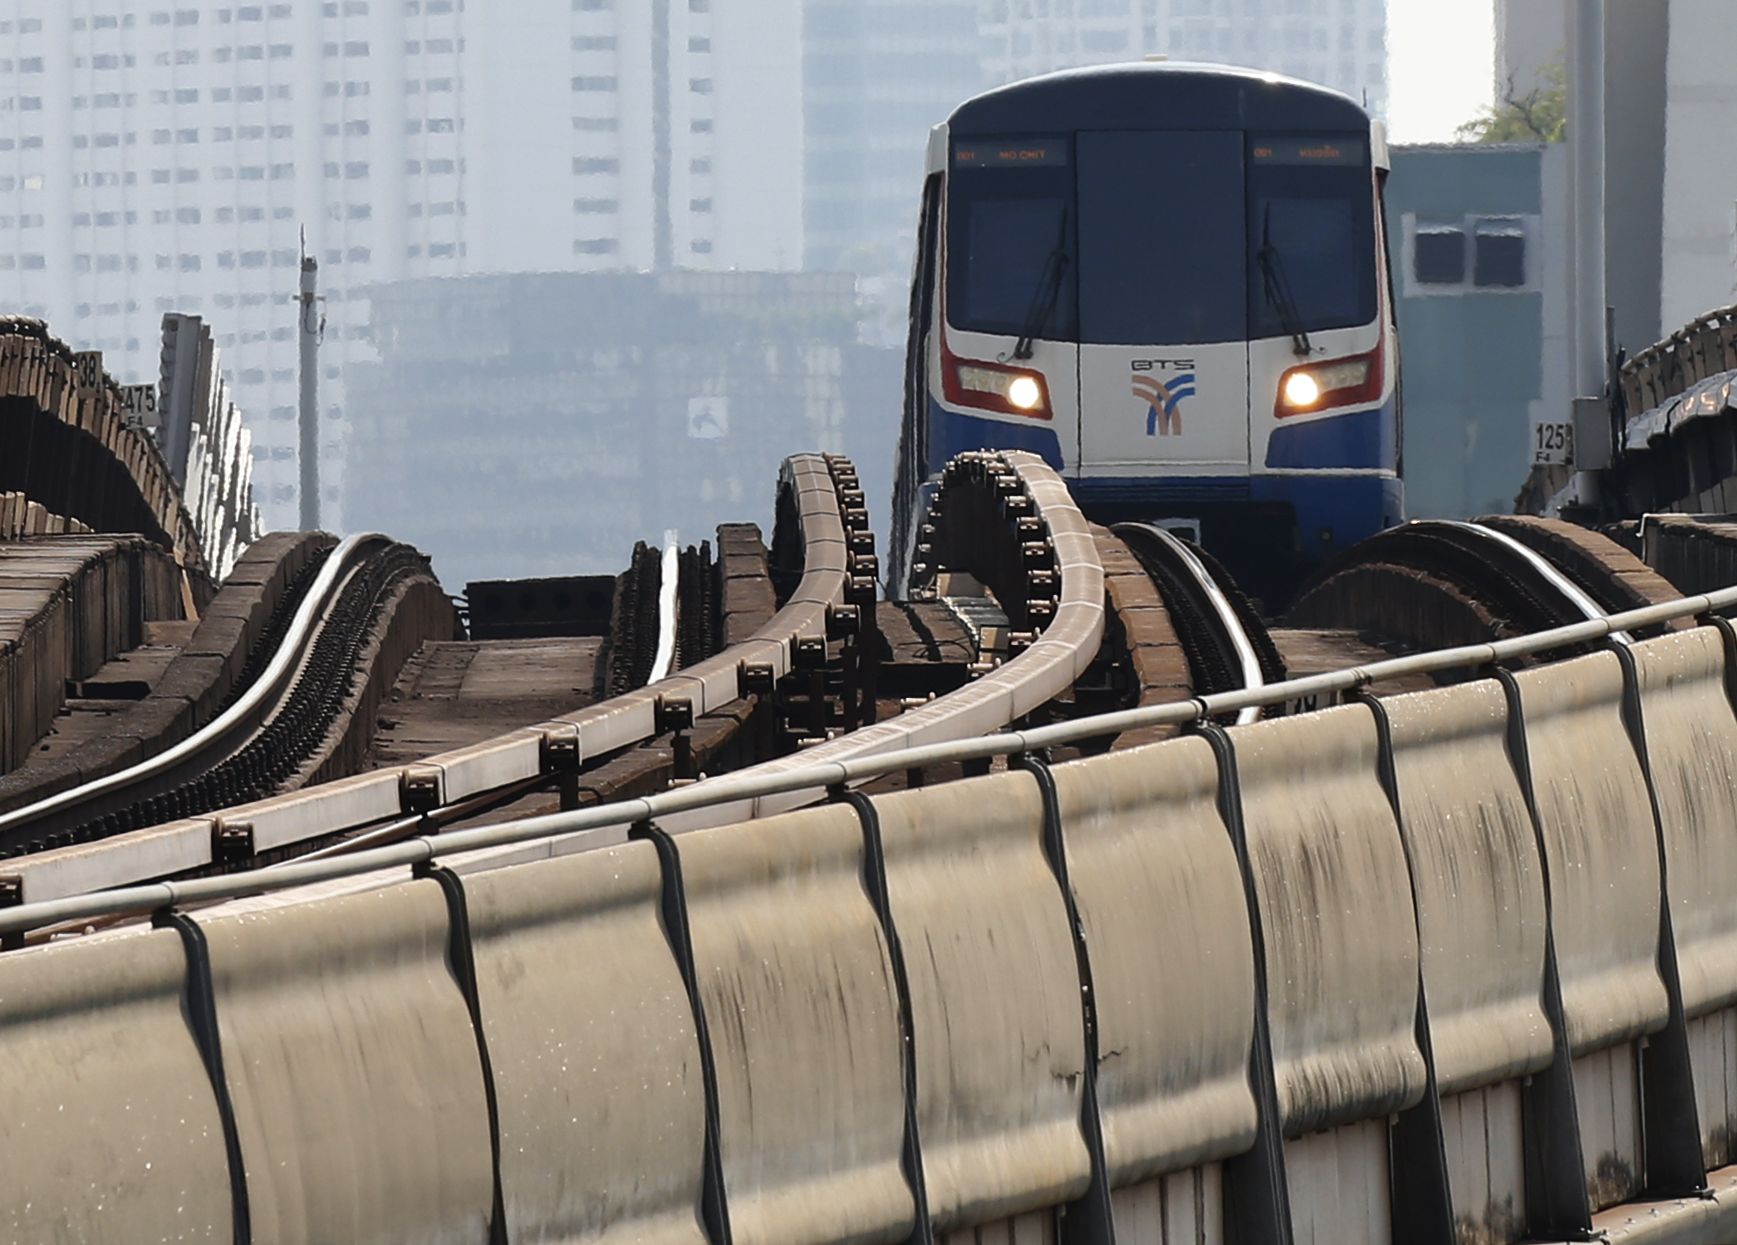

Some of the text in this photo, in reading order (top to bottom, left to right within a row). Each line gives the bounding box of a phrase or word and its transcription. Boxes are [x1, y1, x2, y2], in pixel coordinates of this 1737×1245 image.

[999, 150, 1016, 160] MO
[1020, 149, 1046, 160] CHIT
[1131, 359, 1195, 371] BTS
[126, 385, 156, 414] 475
[1536, 423, 1564, 450] 125
